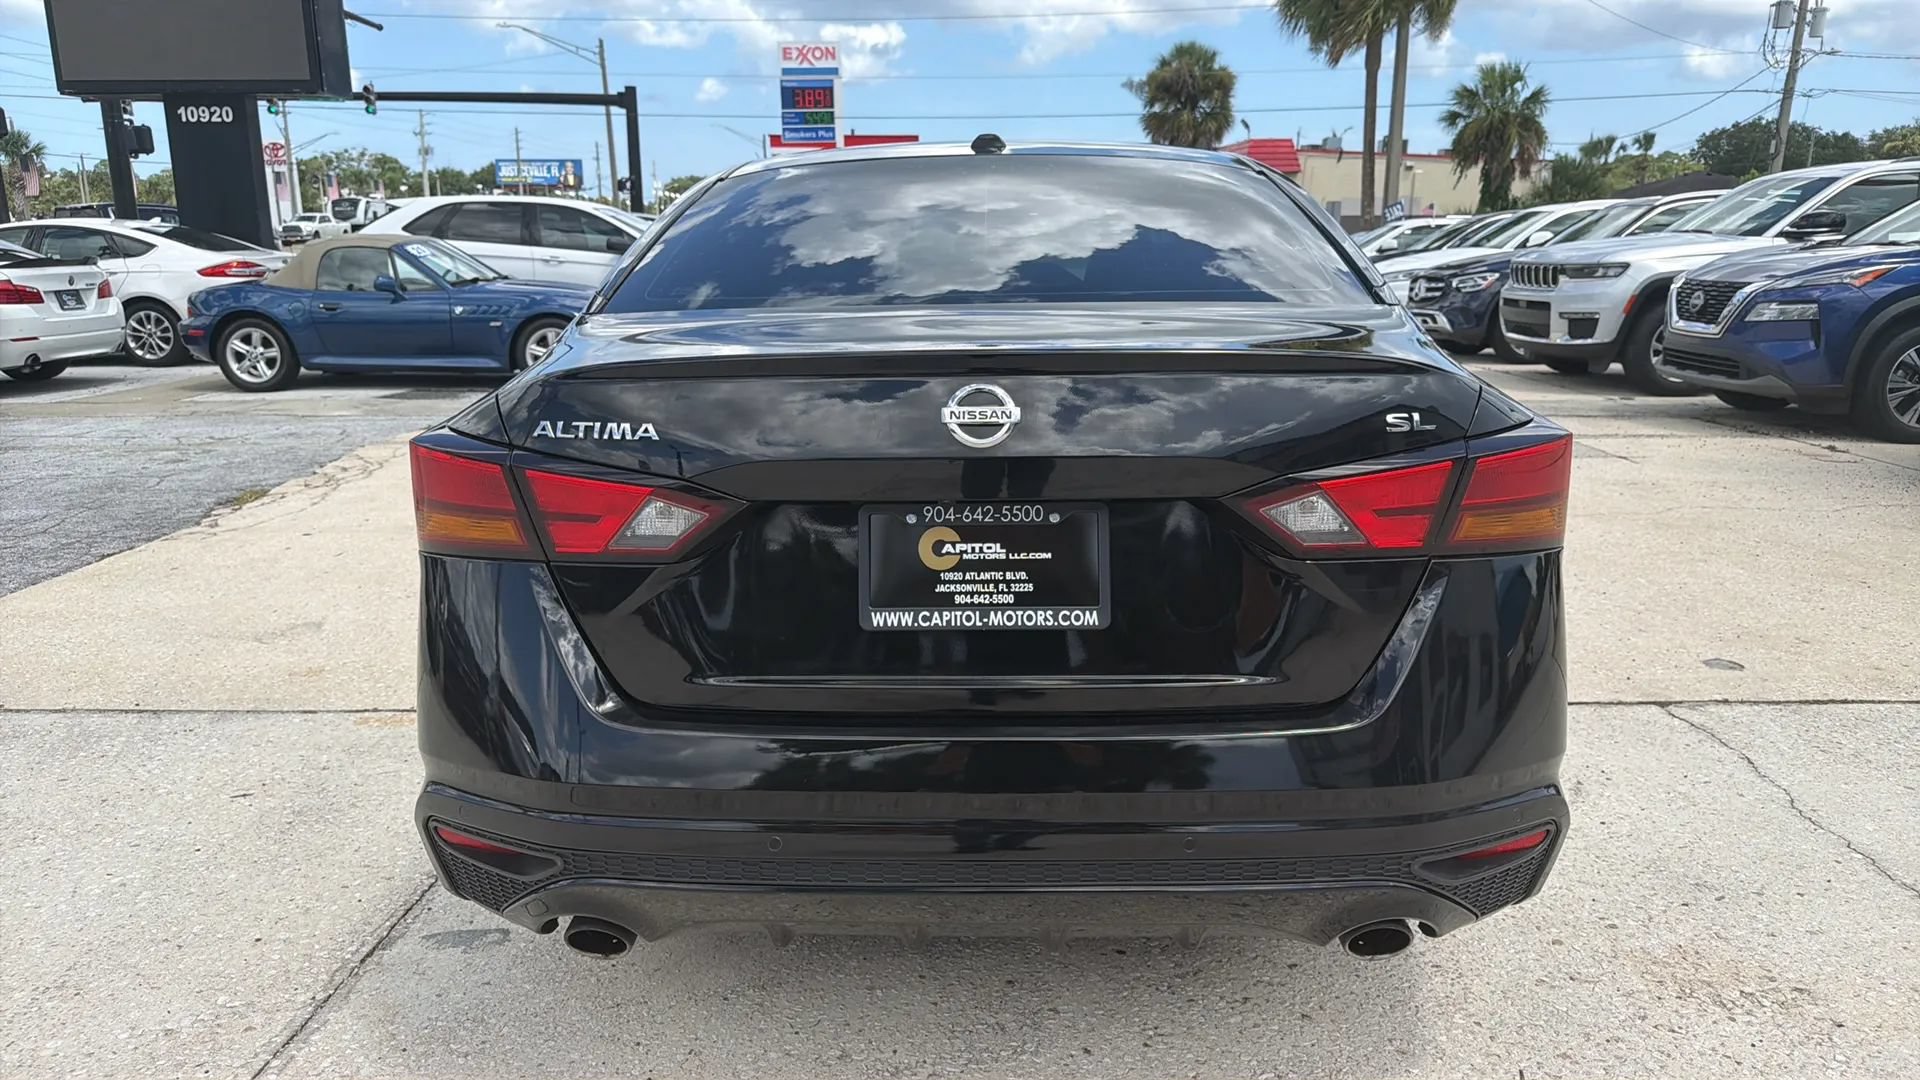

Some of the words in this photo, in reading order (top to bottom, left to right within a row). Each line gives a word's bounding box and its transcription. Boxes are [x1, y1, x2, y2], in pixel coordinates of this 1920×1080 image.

[782, 45, 837, 66] EXXON
[177, 106, 233, 122] 10920
[784, 130, 816, 139] Smokers
[818, 130, 833, 138] Plus
[950, 410, 1012, 420] NISSAN
[1386, 412, 1437, 432] SL
[532, 420, 660, 441] ALTIMA
[923, 505, 1044, 522] 904-642-5500
[918, 526, 1006, 571] CAPITOL
[1009, 552, 1052, 560] LLC.COM
[940, 572, 963, 581] 10920
[965, 572, 1004, 581] ATLANTIC
[1006, 572, 1029, 580] BLVD.
[935, 584, 997, 593] JACKSONVILLE,
[999, 584, 1009, 593] FL
[1010, 583, 1034, 592] 32225
[954, 594, 1014, 604] 904-642-5500
[871, 610, 1099, 628] WWW.CAPITOL-MOTORS.COM
